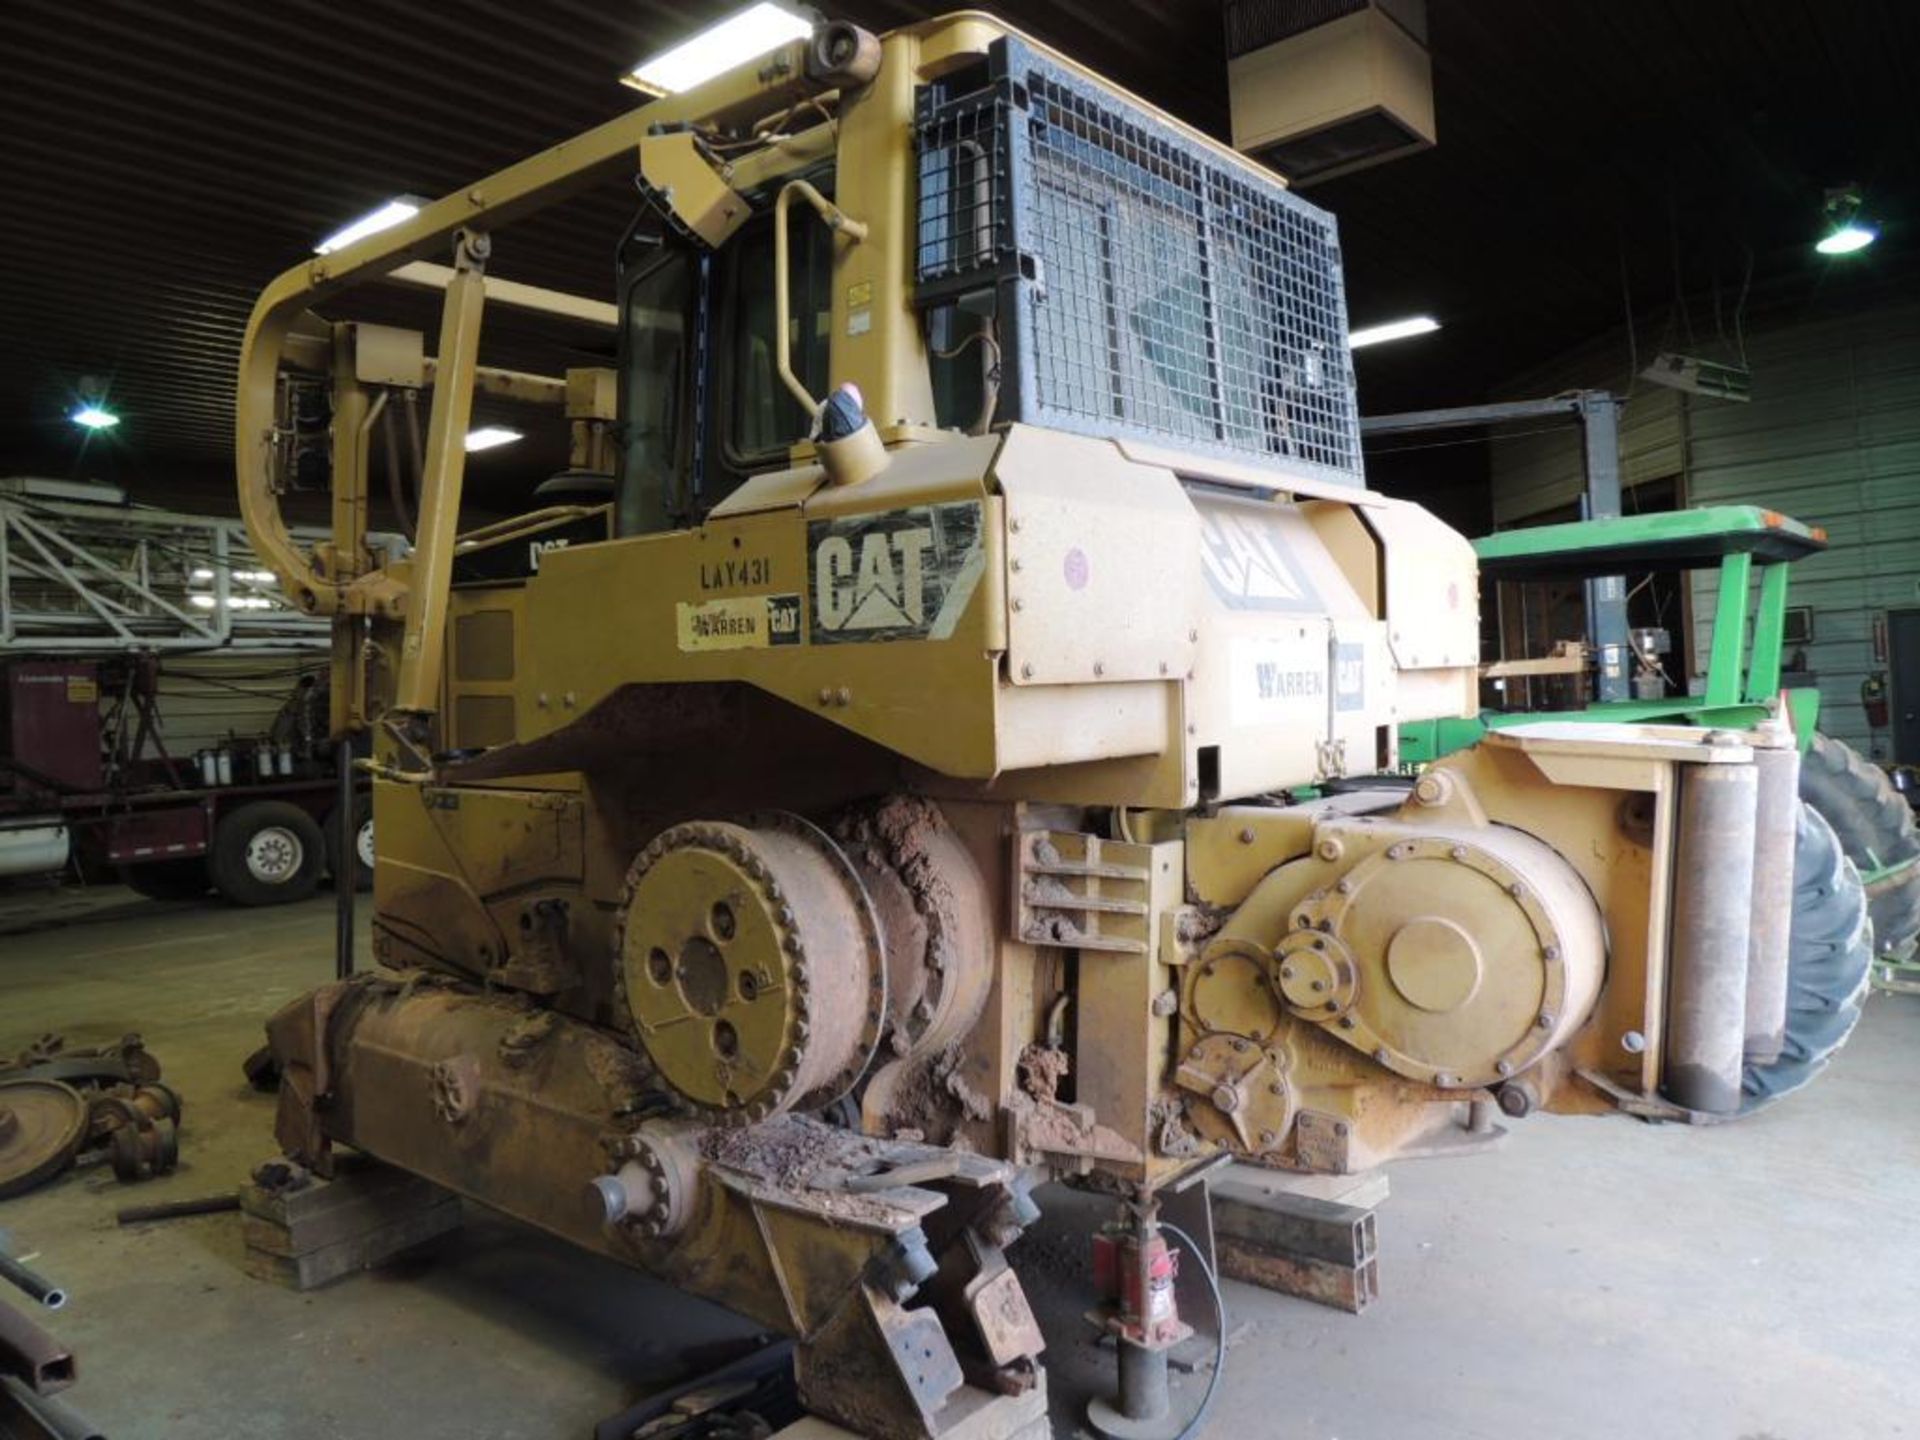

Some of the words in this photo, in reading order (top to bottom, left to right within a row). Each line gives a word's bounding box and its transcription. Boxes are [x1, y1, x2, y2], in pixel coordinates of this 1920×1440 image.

[701, 558, 769, 589] LAY431
[1200, 512, 1304, 599] CAT
[816, 527, 931, 630] CAT
[691, 614, 756, 637] WARREN
[770, 607, 797, 633] CAT
[1256, 661, 1323, 699] WARREN
